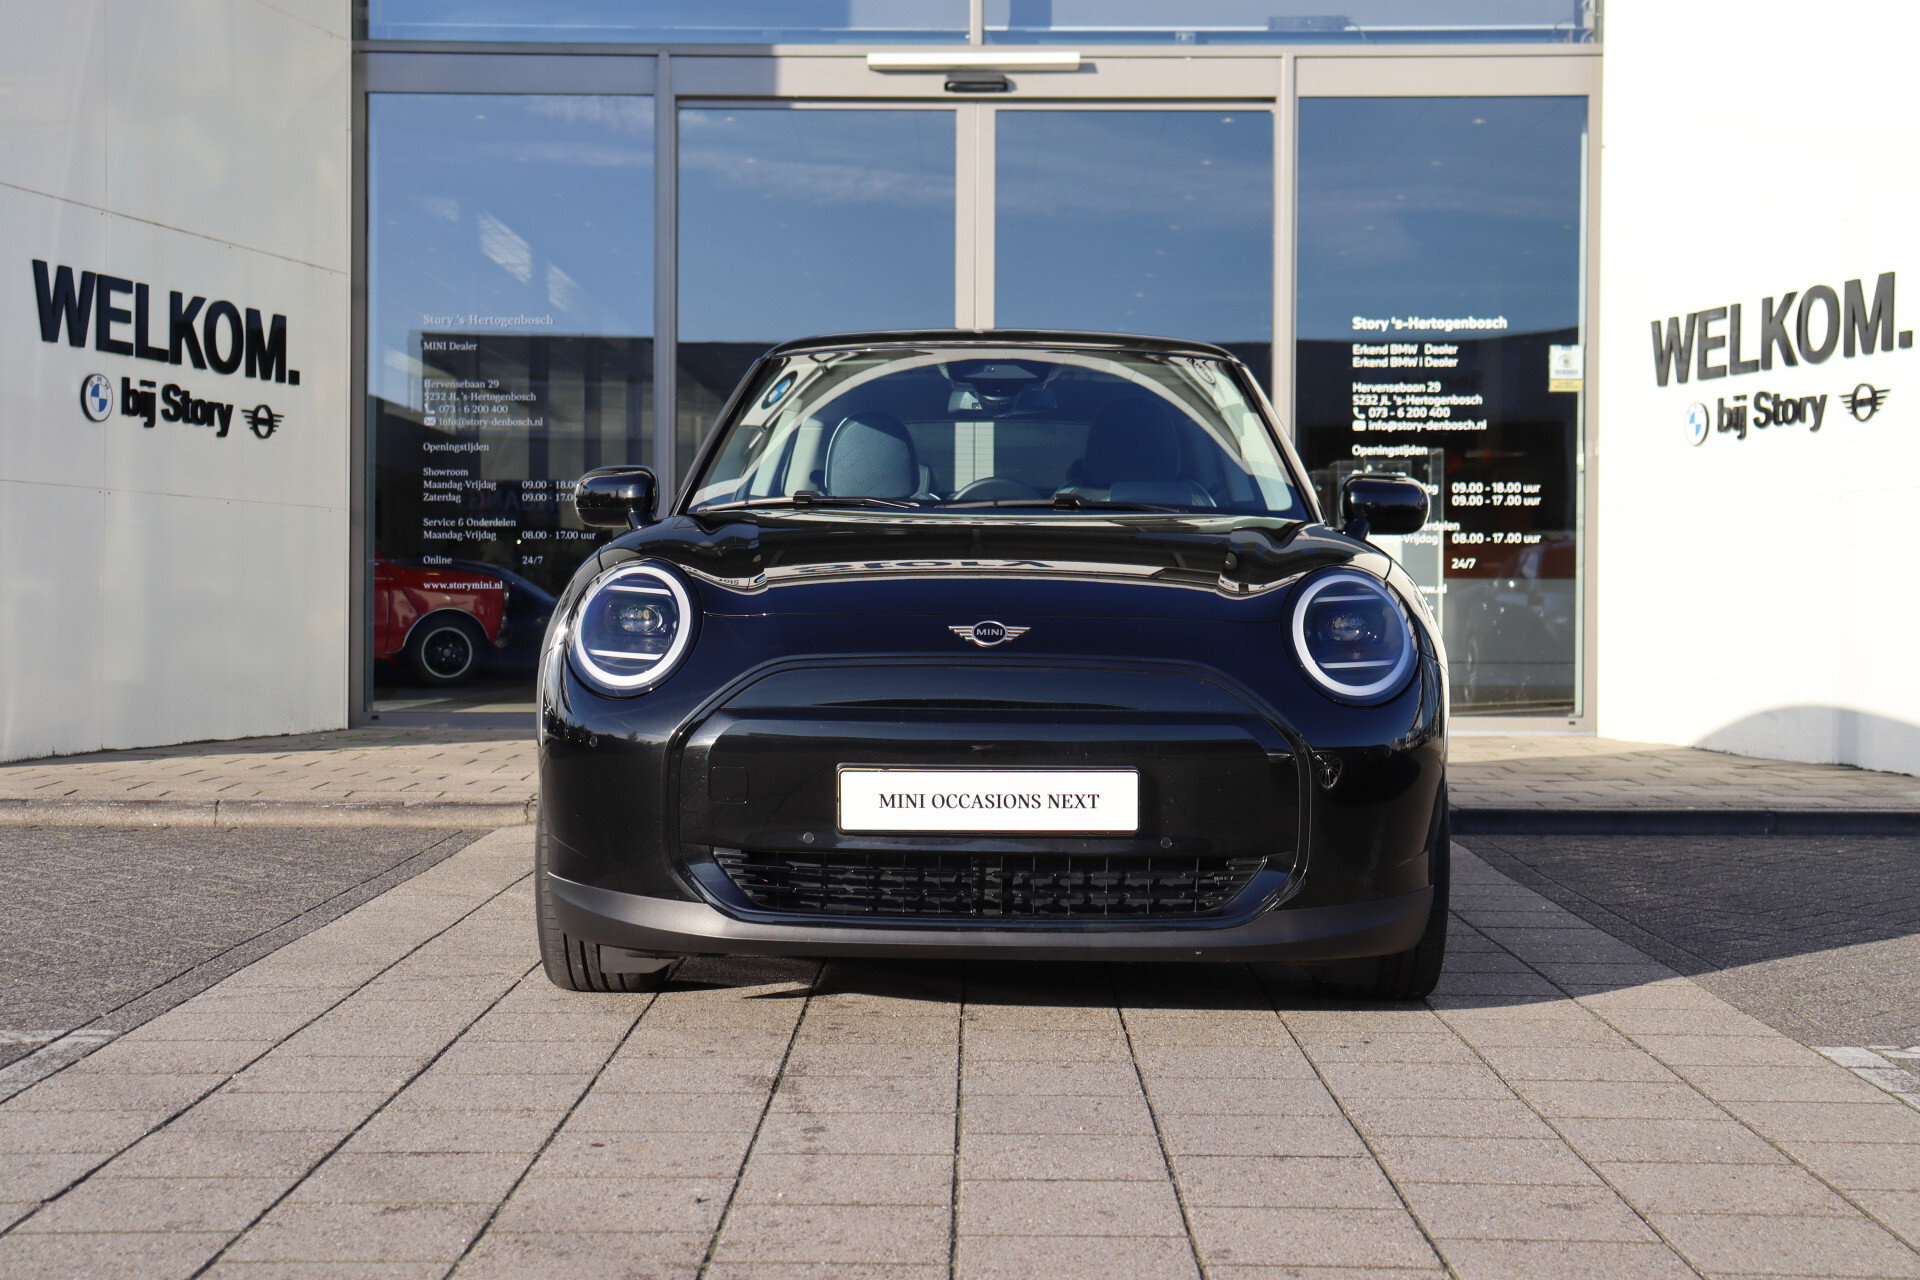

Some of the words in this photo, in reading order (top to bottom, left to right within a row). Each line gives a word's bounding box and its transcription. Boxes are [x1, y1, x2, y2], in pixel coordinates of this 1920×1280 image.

[32, 258, 301, 385] WELKOM.
[423, 314, 452, 327] Story
[1352, 316, 1389, 332] Story
[1391, 315, 1507, 332] 's-Hertogenbosch
[1651, 271, 1913, 387] WELKOM.
[423, 342, 447, 351] MINI
[449, 342, 478, 351] Dealer
[1352, 344, 1388, 355] Erkend
[1389, 344, 1418, 355] BMW
[1424, 344, 1458, 355] Dealer
[1352, 357, 1388, 368] Erkend
[1389, 357, 1418, 368] BMW
[1424, 357, 1458, 368] Dealer
[424, 380, 486, 389] Hervensebaan
[488, 380, 500, 389] 29
[1352, 382, 1426, 393] Hervensebaan
[1427, 382, 1441, 393] 29
[424, 392, 446, 401] 5232
[1352, 394, 1378, 406] 5232
[1379, 394, 1391, 406] JL
[121, 376, 157, 428] bij
[161, 383, 234, 438] Story
[439, 405, 456, 414] 073
[463, 405, 470, 414] 6
[472, 405, 489, 414] 200
[491, 405, 508, 414] 400
[1368, 407, 1388, 418] 073
[1396, 407, 1405, 418] 6
[1406, 407, 1427, 418] 200
[1429, 407, 1450, 418] 400
[1717, 394, 1747, 440] bij
[1753, 390, 1828, 432] Story
[1367, 419, 1487, 433] info@story-denbosch.nl
[423, 442, 490, 453] Openingstijden
[1352, 444, 1428, 457] Openingstijden
[423, 468, 469, 477] Showroom
[423, 480, 497, 491] Maandag-Vrijdag
[522, 480, 547, 490] 09.00
[1451, 482, 1484, 494] 09.00
[1491, 482, 1522, 494] 18.00
[1523, 484, 1541, 494] uur
[423, 493, 461, 504] Zaterdag
[522, 493, 547, 502] 09.00
[1451, 495, 1484, 507] 09.00
[1523, 496, 1541, 507] uur
[423, 518, 455, 527] Service
[457, 518, 464, 527] &
[466, 518, 517, 527] Onderdelen
[423, 530, 497, 541] Maandag-Vrijdag
[522, 530, 547, 540] 08.00
[555, 530, 579, 540] 17.00
[580, 532, 597, 540] uur
[1451, 532, 1484, 544] 08.00
[1523, 534, 1542, 544] uur
[423, 555, 453, 565] Online
[522, 556, 544, 565] 24/7
[1451, 557, 1477, 569] 24/7
[423, 581, 503, 592] www.storymini.nl
[975, 627, 1004, 637] MINI
[878, 793, 926, 809] MINI
[931, 793, 1042, 810] OCCASIONS
[1047, 793, 1100, 809] NEXT
